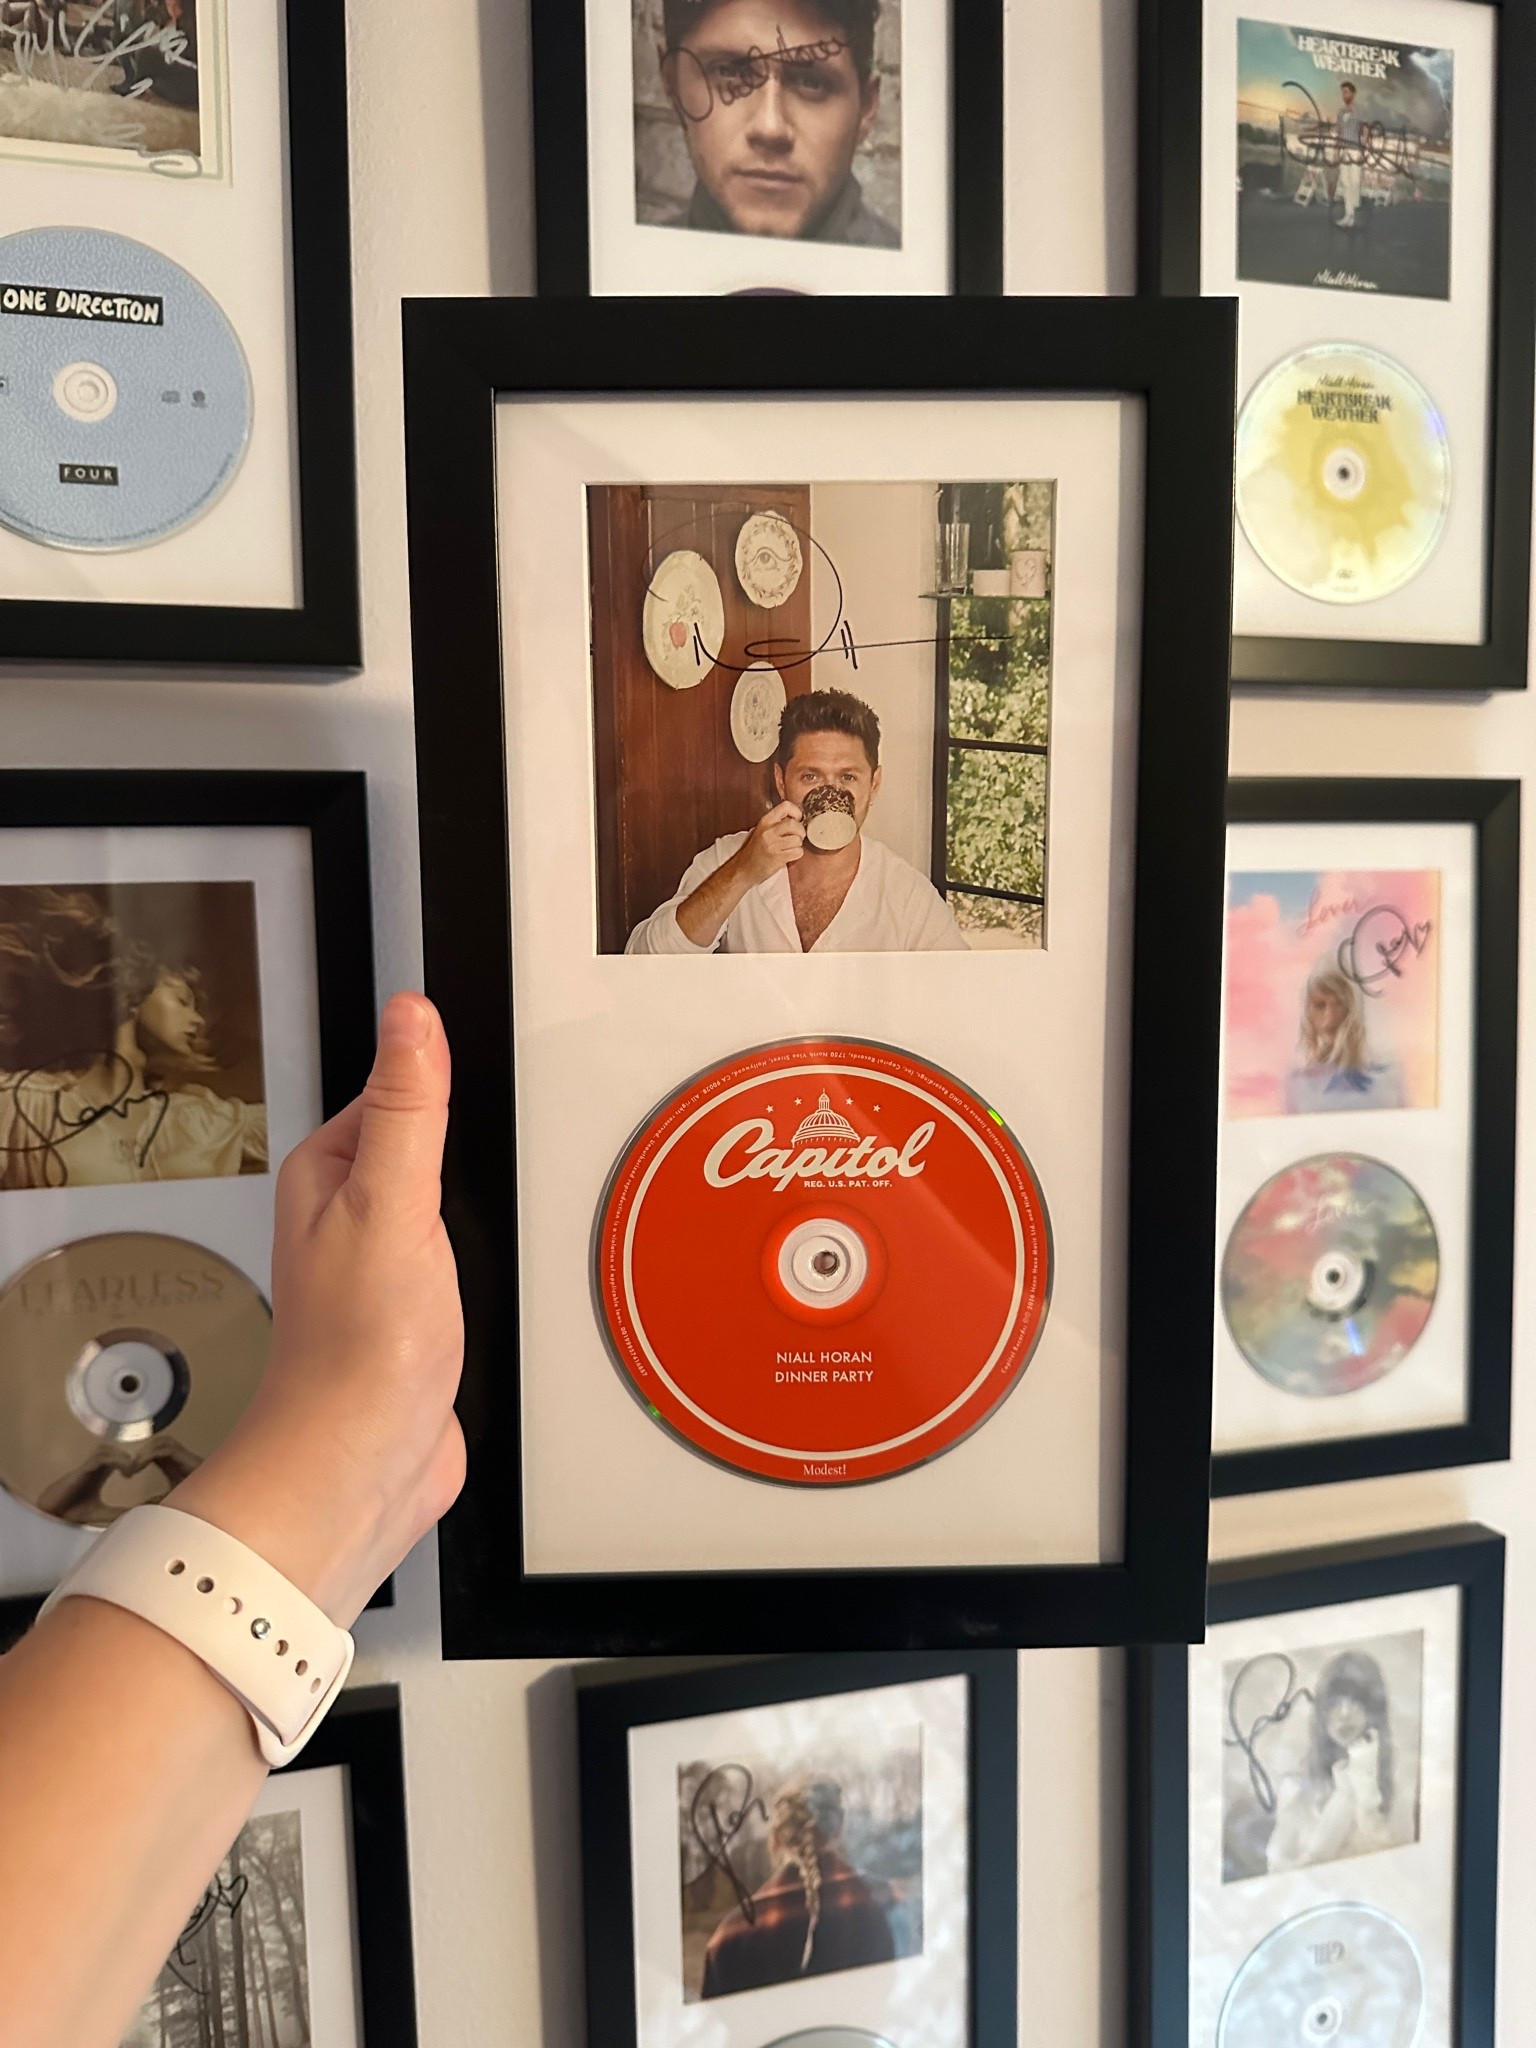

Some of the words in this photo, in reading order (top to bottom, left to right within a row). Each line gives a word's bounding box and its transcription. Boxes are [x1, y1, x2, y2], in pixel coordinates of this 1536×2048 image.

[1298, 35, 1401, 68] HEARTBREAK
[1313, 53, 1388, 79] WEATHER
[3, 288, 47, 312] ONE
[56, 290, 159, 324] DIRECTION
[1297, 390, 1393, 411] HEARTBREAK
[1311, 405, 1380, 424] WEATHER
[64, 467, 114, 480] FOUR
[876, 1058, 901, 1070] Capitol
[720, 1074, 731, 1083] CA
[690, 1093, 700, 1103] All
[948, 1092, 963, 1106] UMG
[674, 1100, 691, 1115] rights
[969, 1109, 987, 1129] license
[986, 1127, 1005, 1152] exclusive
[629, 1139, 656, 1179] Unauthorized
[703, 1118, 936, 1192] Capitol
[1003, 1153, 1016, 1170] under
[804, 1180, 826, 1188] REG.
[828, 1180, 847, 1188] U.S.
[849, 1180, 870, 1188] PAT.
[872, 1180, 893, 1188] OFF.
[1013, 1170, 1024, 1191] Horan
[615, 1178, 632, 1219] reproduction
[1020, 1191, 1030, 1208] Niall
[1025, 1208, 1034, 1221] and
[609, 1273, 619, 1307] applicable
[776, 1351, 816, 1364] NIALL
[820, 1351, 873, 1363] HORAN
[775, 1370, 829, 1383] DINNER
[832, 1370, 874, 1382] PARTY
[803, 1463, 846, 1476] Modest!
